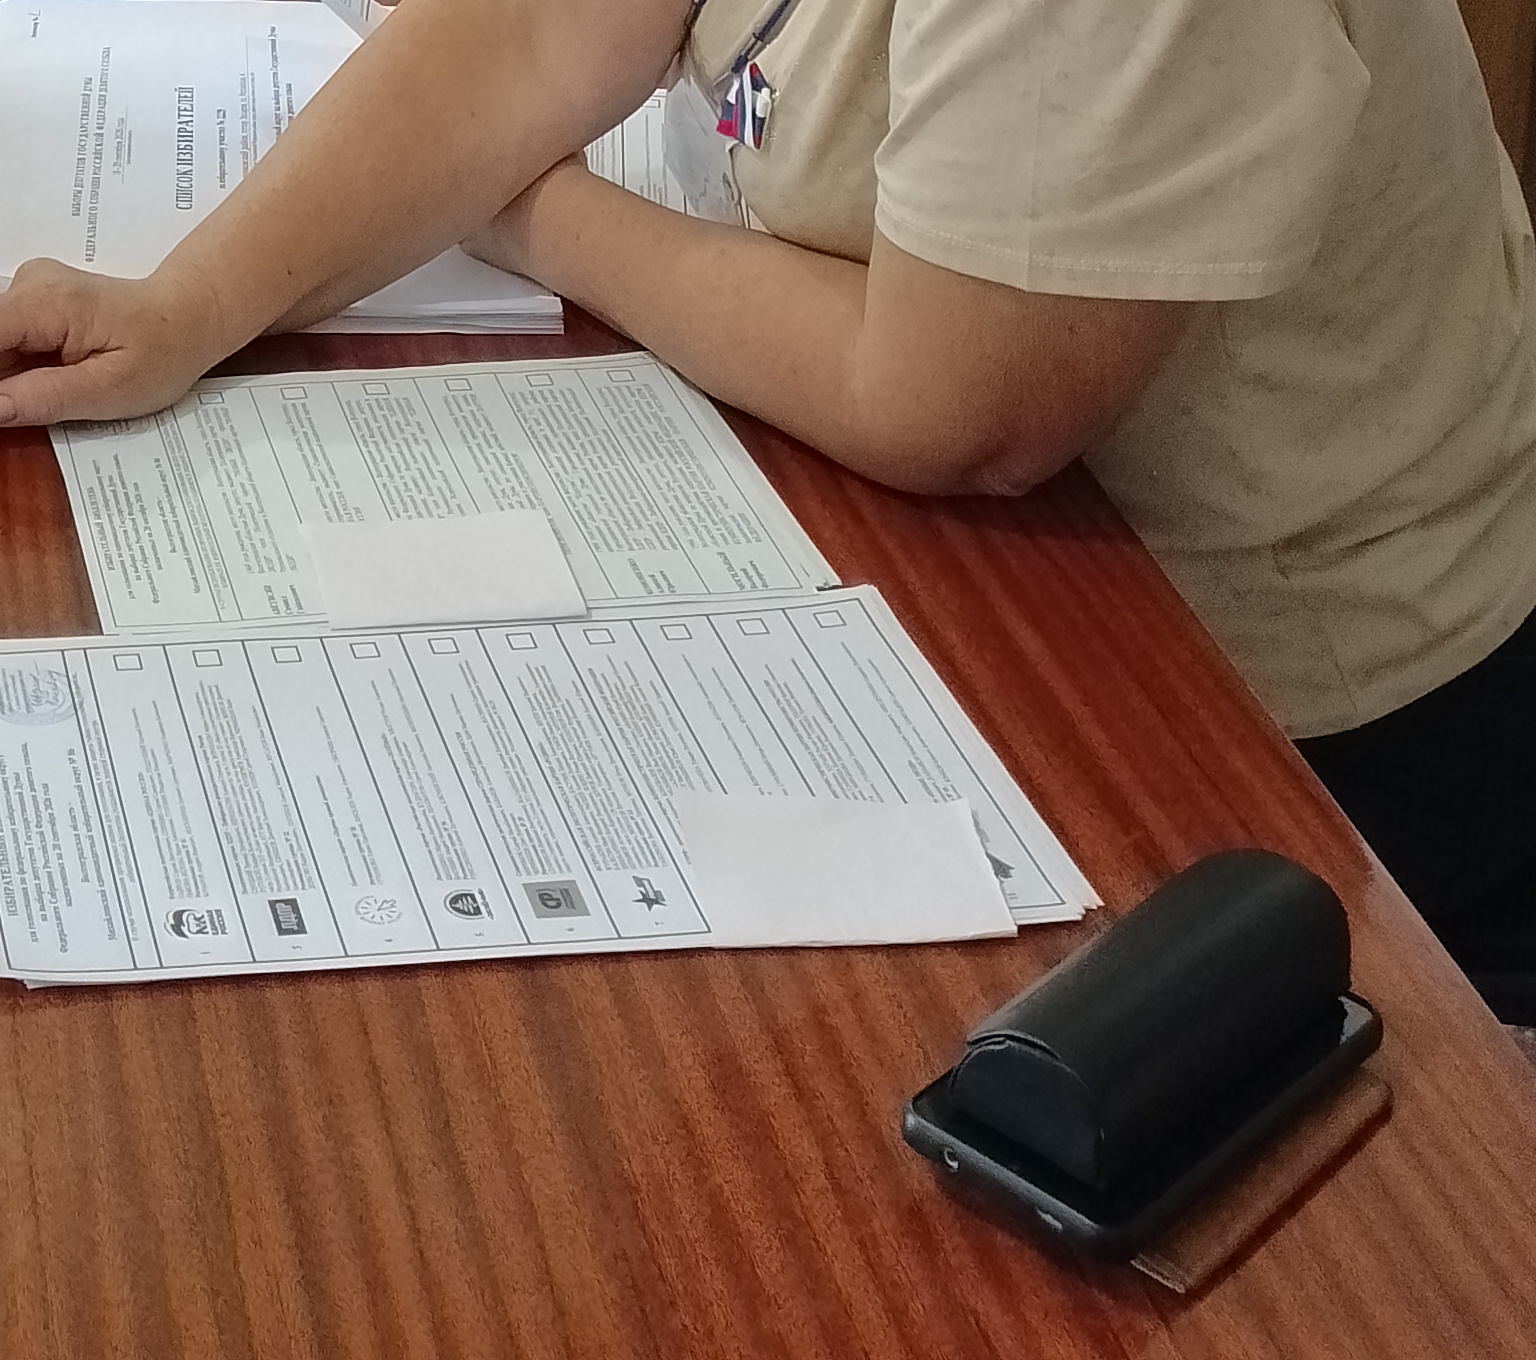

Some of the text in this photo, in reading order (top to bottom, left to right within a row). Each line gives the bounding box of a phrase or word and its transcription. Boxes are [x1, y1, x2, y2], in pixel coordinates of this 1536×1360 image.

[76, 93, 90, 155] ГОСУДАРСТВЕННОЙ
[174, 85, 194, 209] СПИСОК ИЗБИРАТЕЛЕЙ
[71, 189, 83, 216] ВЫБОРЫ
[73, 157, 85, 188] ДЕПУТАТОВ
[84, 205, 98, 262] ФЕДЕРАЛЬНОГО
[91, 132, 104, 174] РОССИЙСКОЙ
